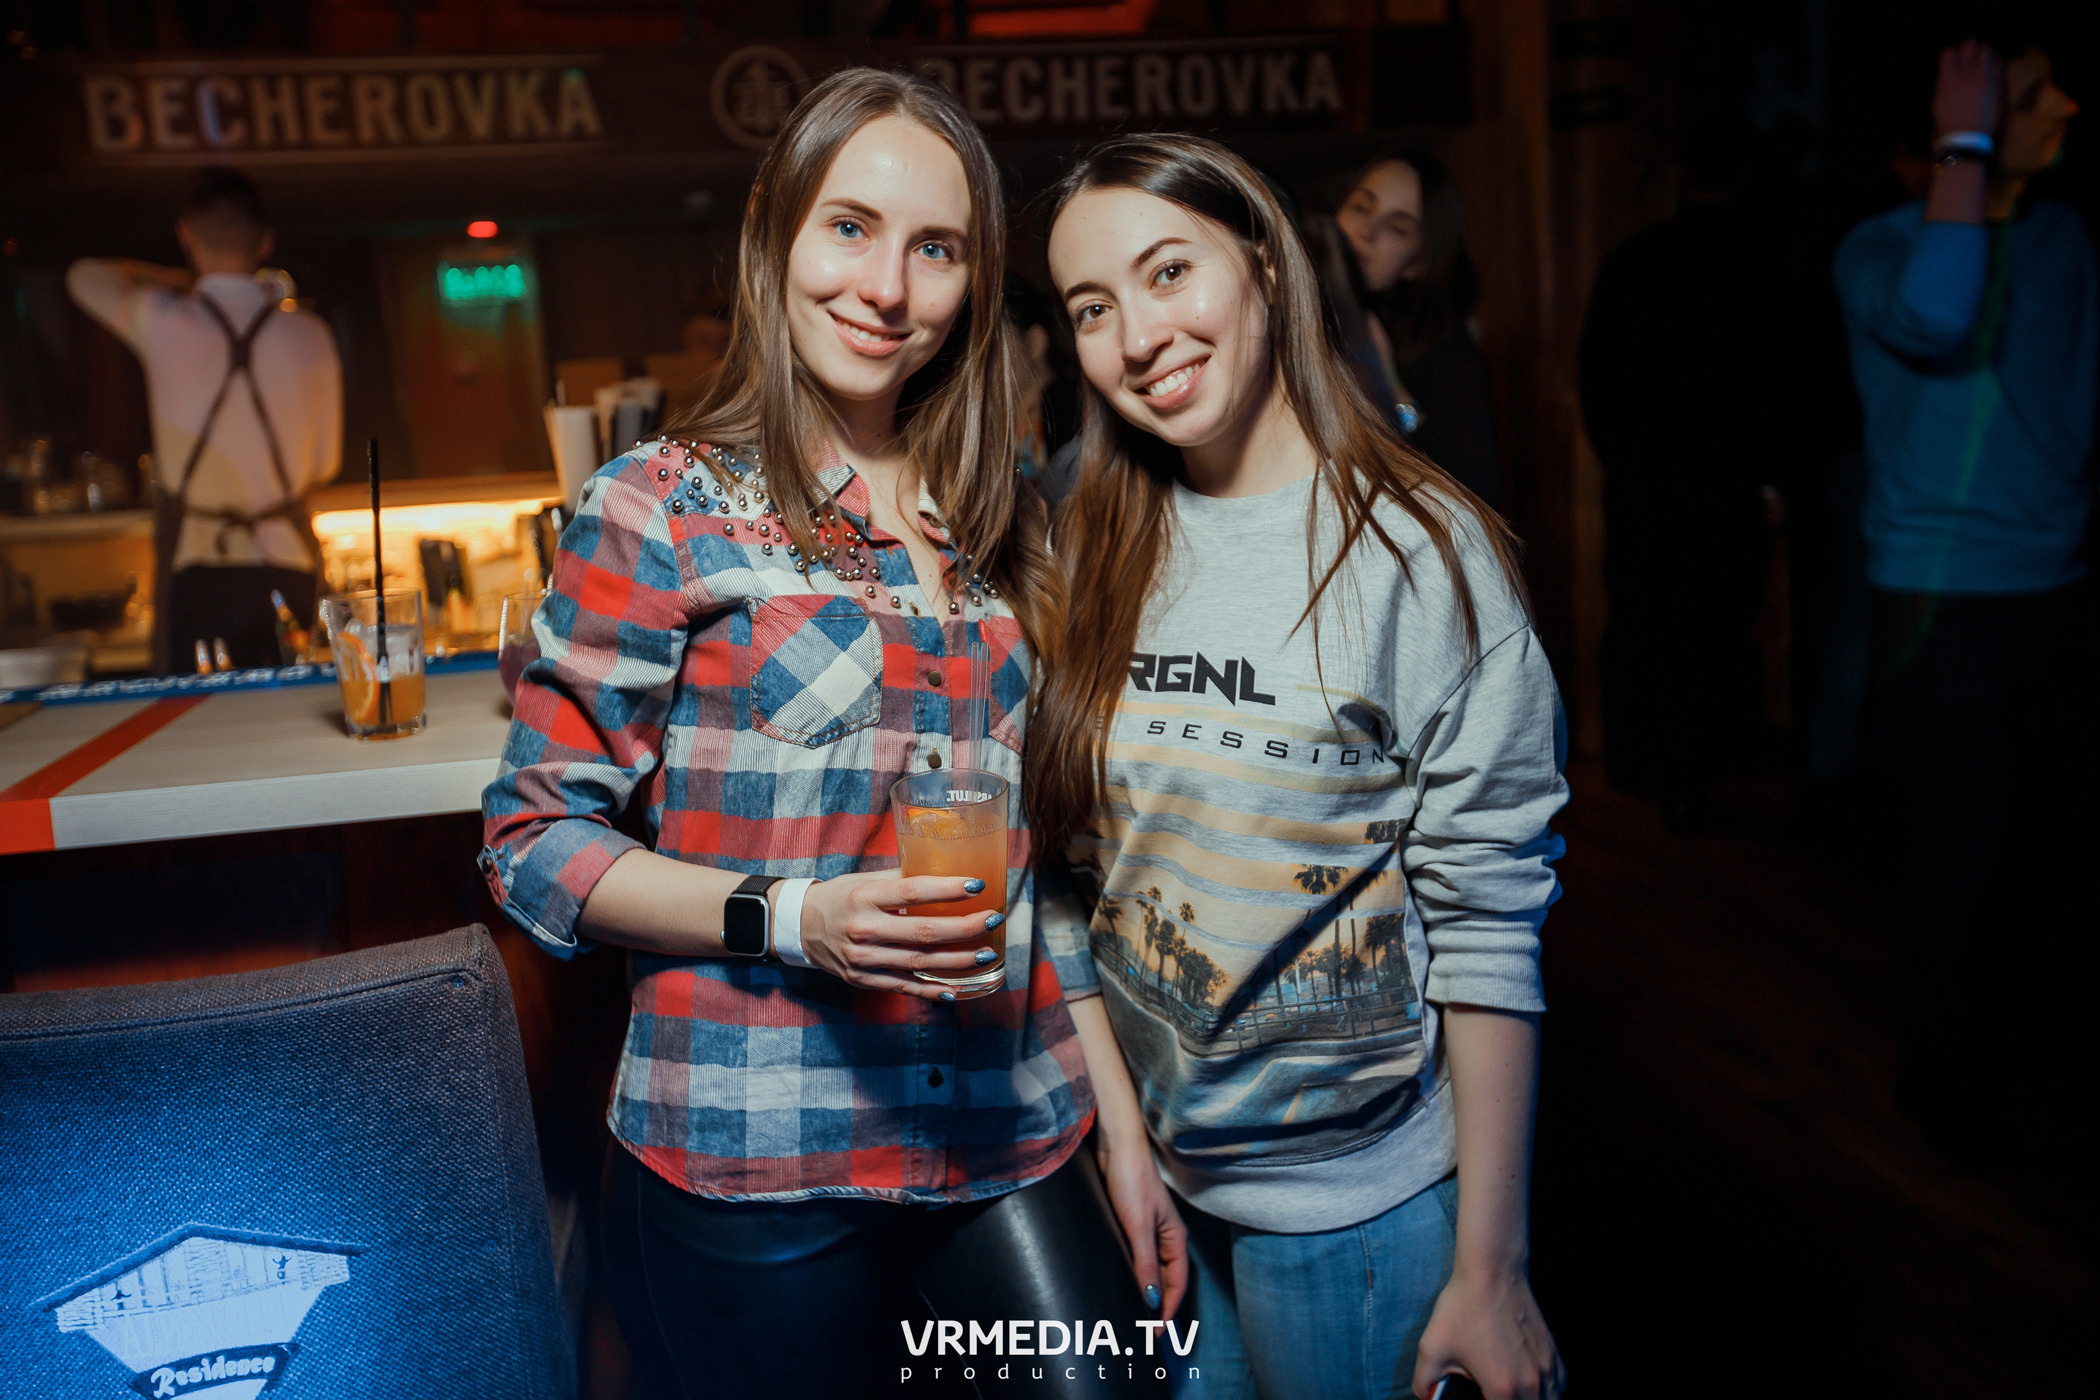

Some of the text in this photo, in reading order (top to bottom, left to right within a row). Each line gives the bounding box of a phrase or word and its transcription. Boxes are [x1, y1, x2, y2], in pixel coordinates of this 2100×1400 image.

[84, 67, 603, 152] BECHEROVKA
[1146, 720, 1384, 766] SESSION
[150, 1355, 275, 1398] Residence
